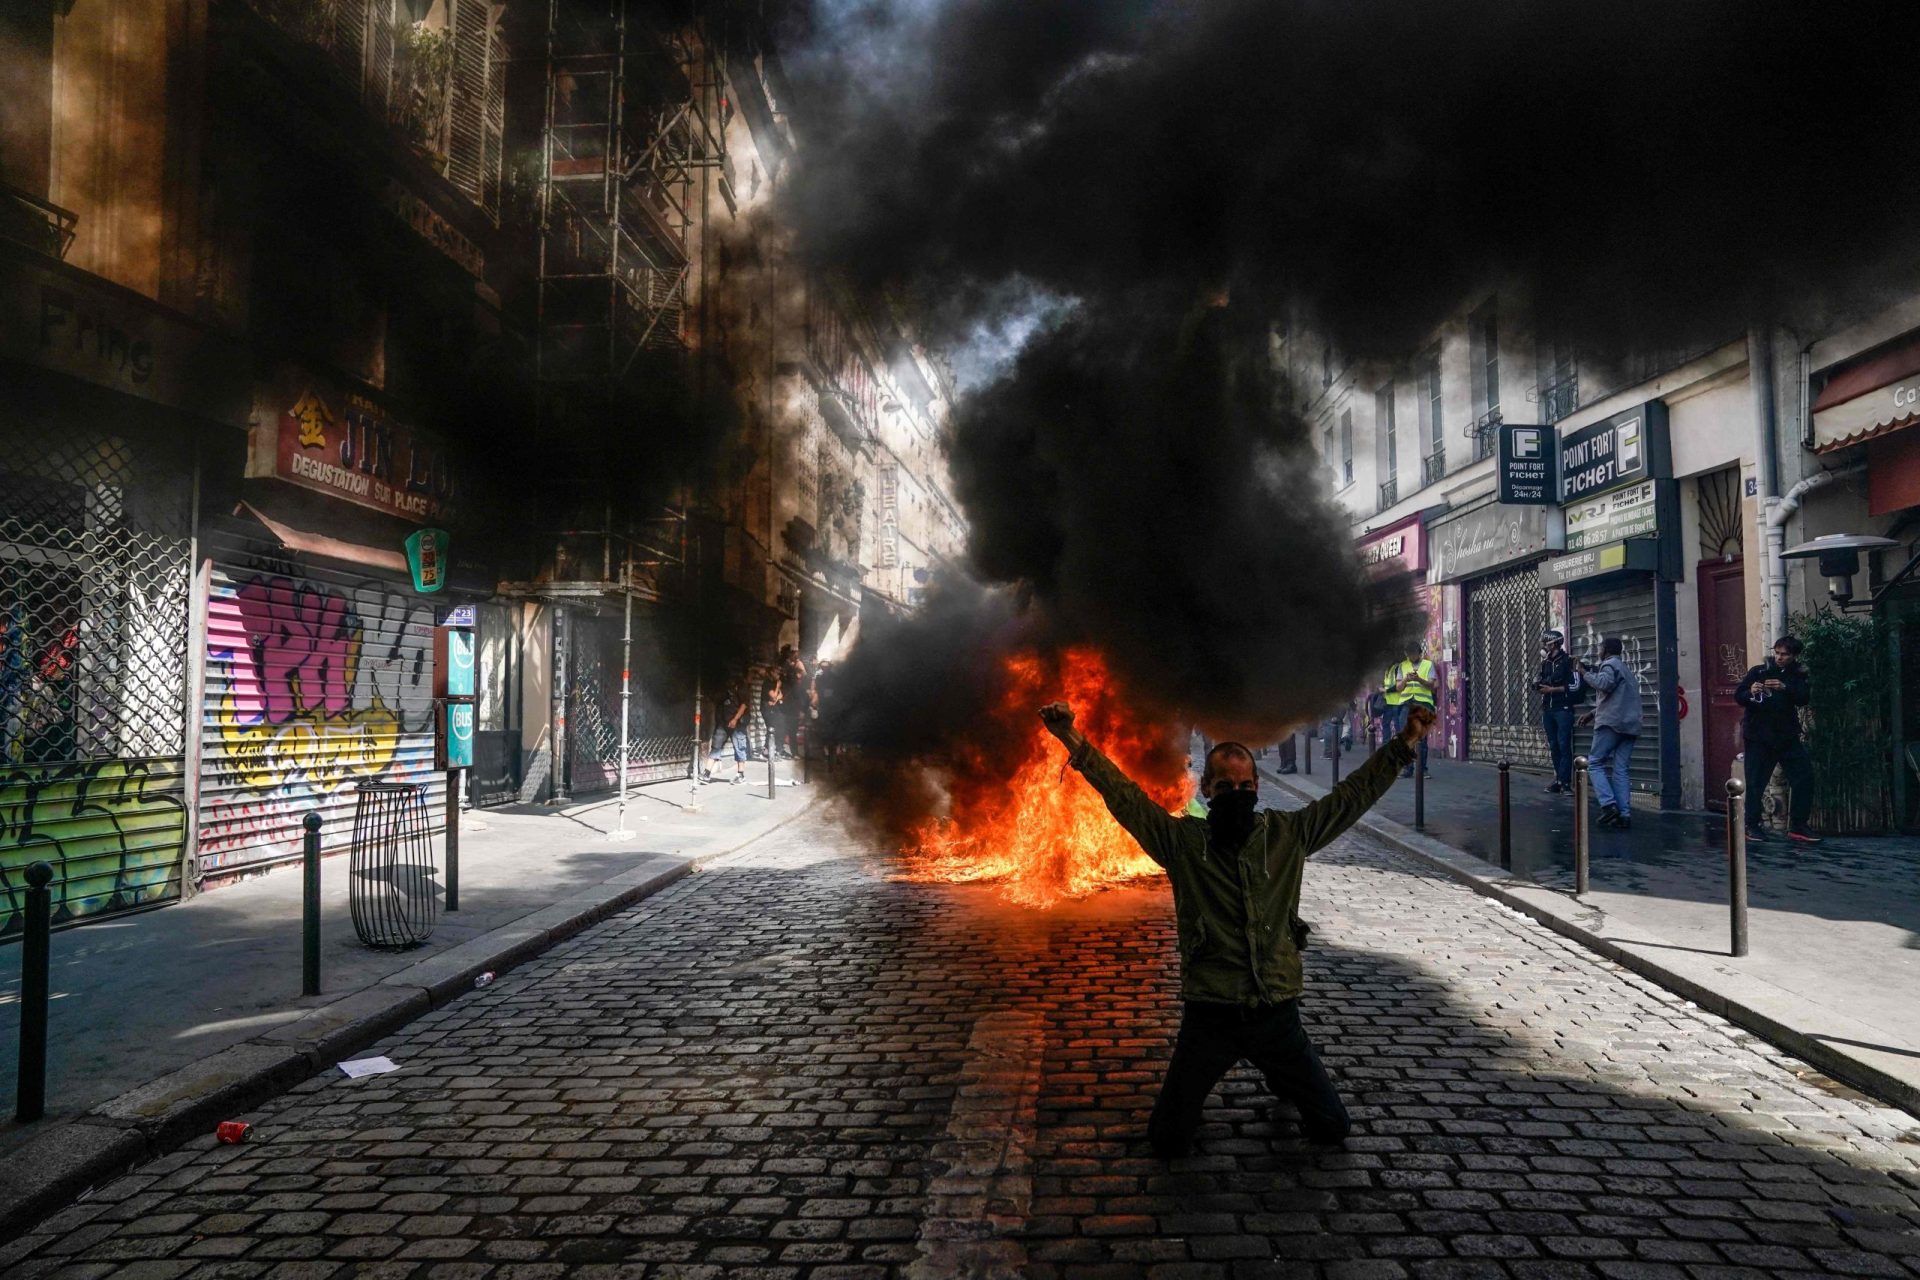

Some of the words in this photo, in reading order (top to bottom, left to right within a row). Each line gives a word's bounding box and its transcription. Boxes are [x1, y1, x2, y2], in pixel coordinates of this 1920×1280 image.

[1894, 385, 1920, 407] Ca
[1563, 440, 1589, 471] POINT
[1591, 429, 1615, 460] FORT
[1509, 462, 1528, 470] POINT
[1529, 462, 1545, 471] FORT
[374, 482, 392, 505] SUR
[395, 491, 428, 516] PLACE
[1612, 491, 1626, 502] POINT
[1627, 486, 1640, 498] FORT
[1380, 536, 1402, 561] QUEEN
[1568, 539, 1575, 550] 01
[1575, 535, 1583, 548] 48
[1583, 533, 1591, 546] 06
[1591, 530, 1599, 543] 28
[1600, 529, 1608, 542] 57
[423, 569, 434, 579] 75
[462, 609, 471, 617] 23
[456, 638, 473, 656] BUS
[456, 712, 472, 727] BUS
